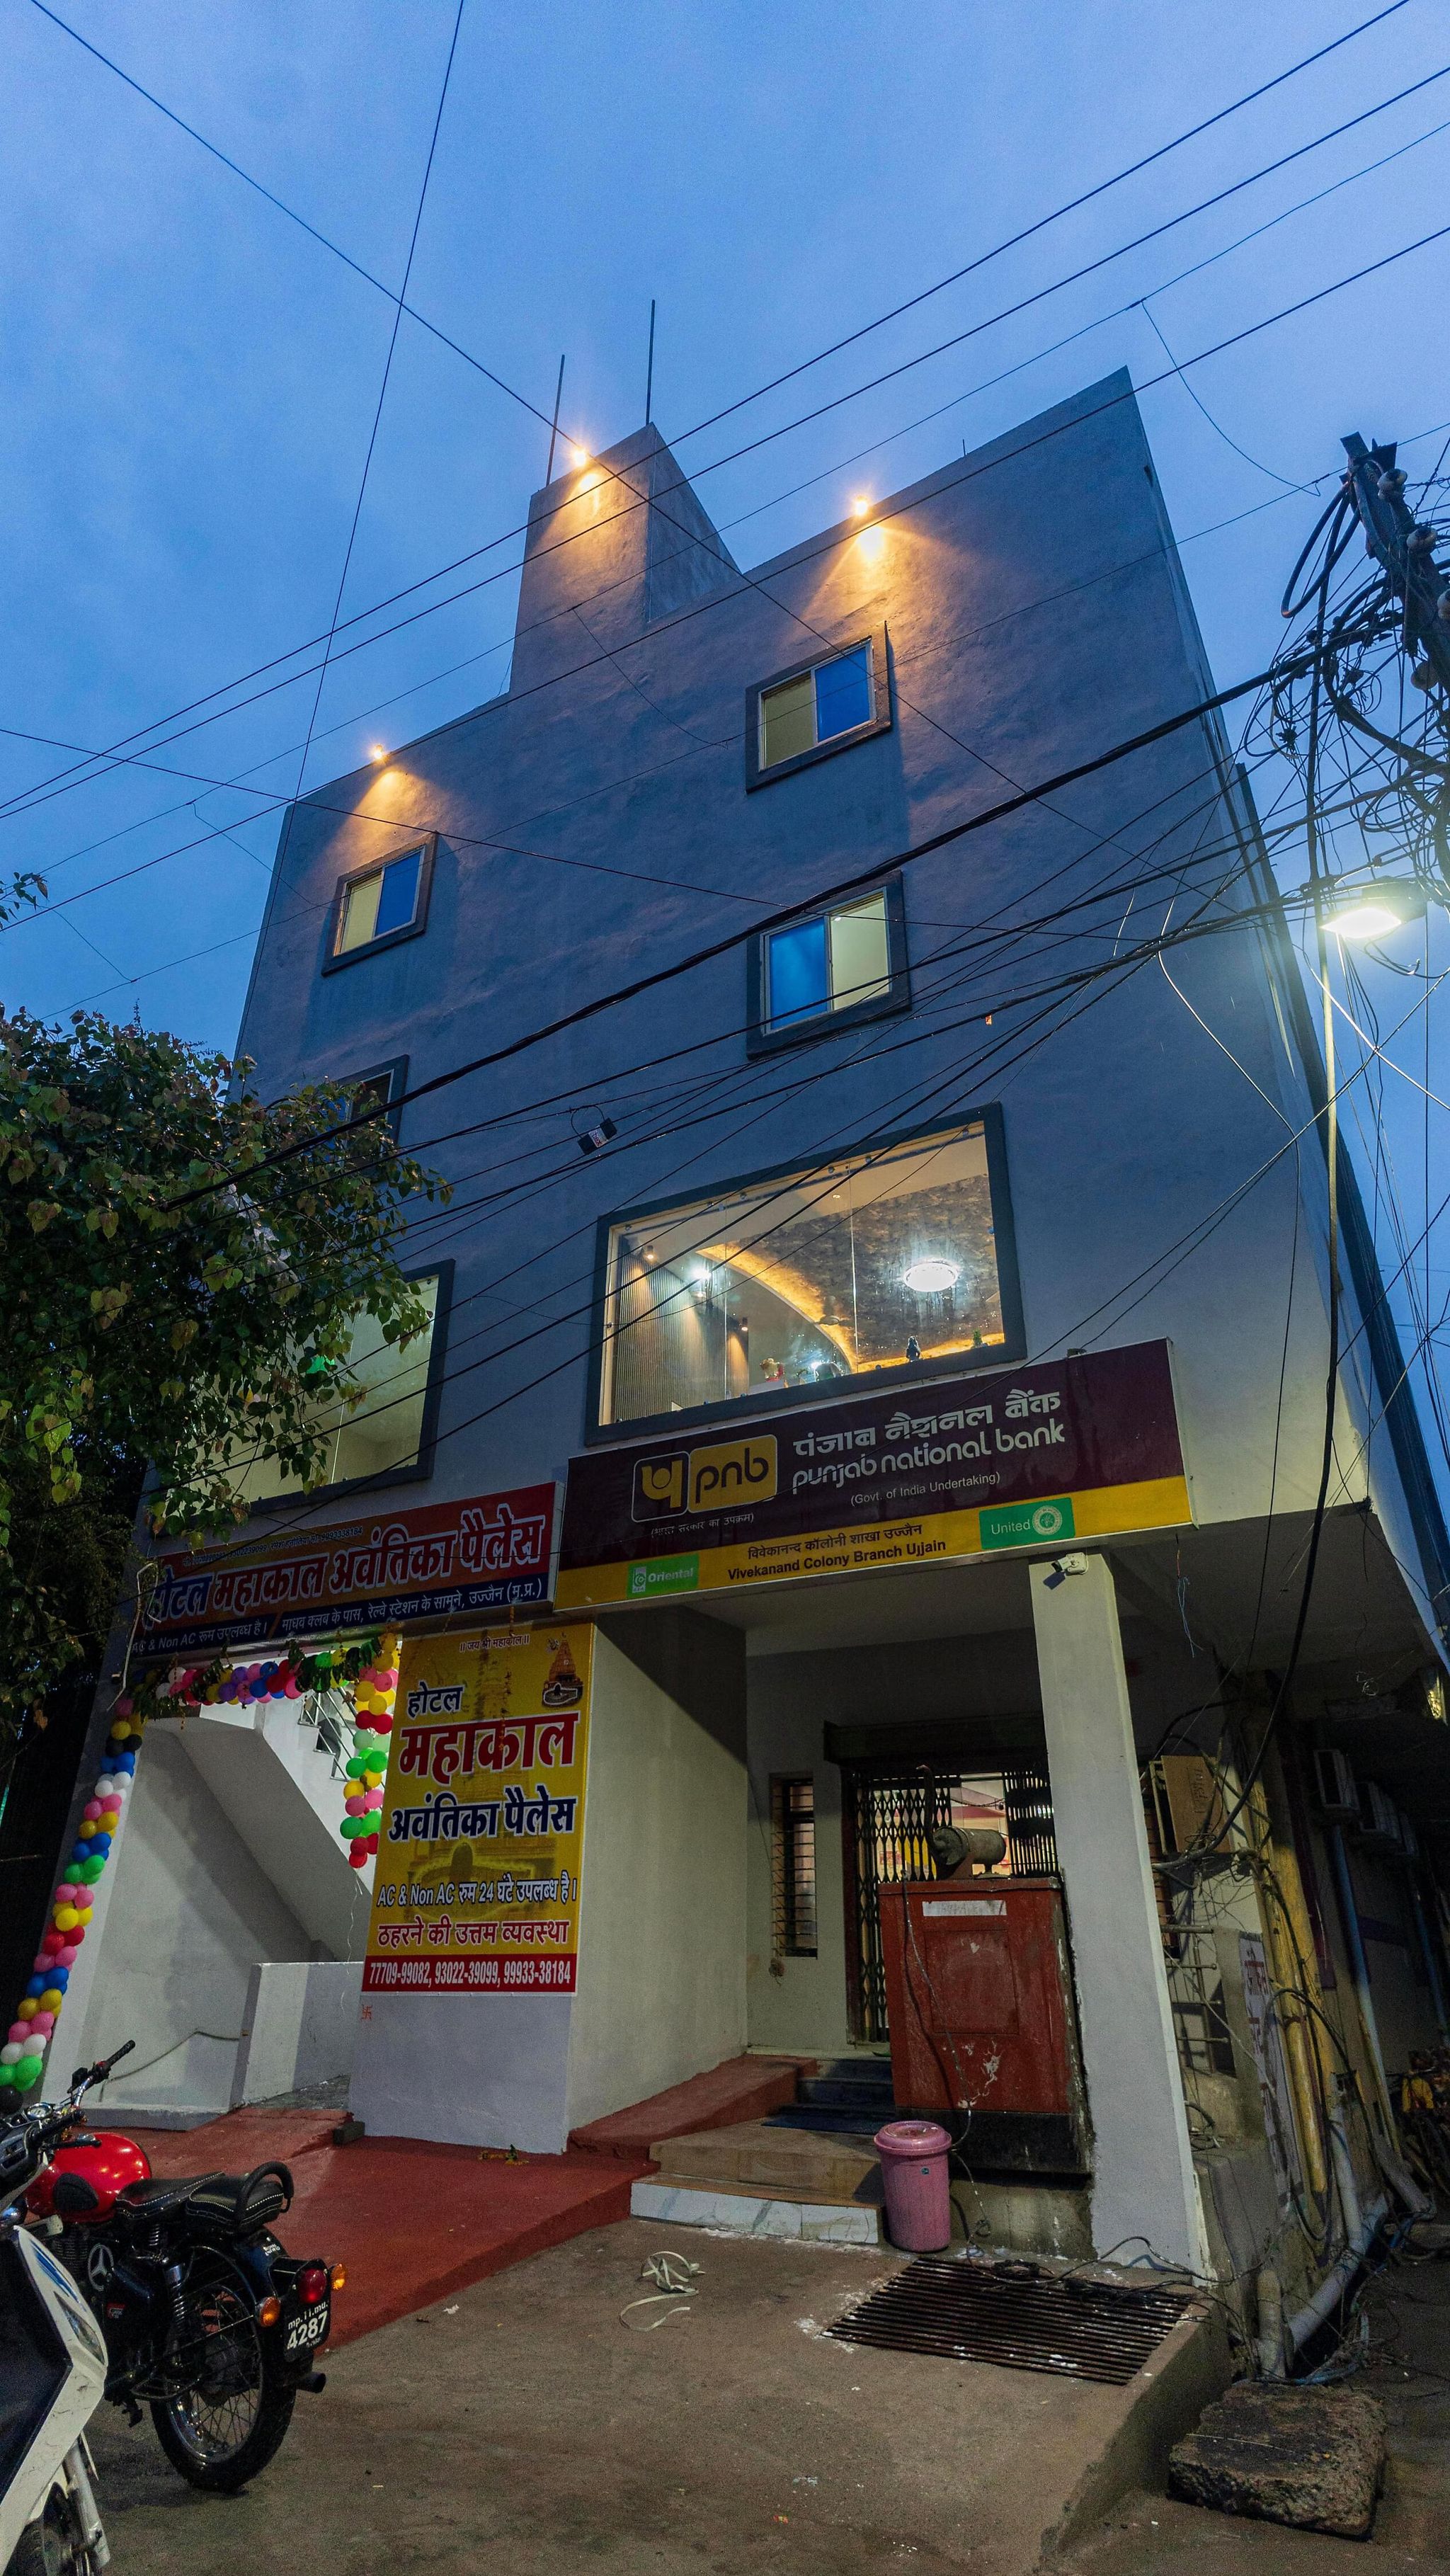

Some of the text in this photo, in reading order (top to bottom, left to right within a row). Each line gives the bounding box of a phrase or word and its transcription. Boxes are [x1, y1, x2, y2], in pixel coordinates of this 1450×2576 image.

[792, 1389, 1061, 1457] पंजाब नैशनल बैंक
[695, 1447, 769, 1504] pnb
[792, 1418, 1066, 1495] punjab national bank
[850, 1471, 1000, 1507] (Govt. of India Undertaking)
[708, 1517, 721, 1529] का
[748, 1522, 923, 1559] विवेकानन्द कॉलोनी शाखा उज्जैन
[991, 1519, 1030, 1535] United
[213, 1552, 330, 1617] महाकाल
[329, 1524, 459, 1593] अवंतिका
[459, 1503, 545, 1572] पैलेस
[648, 1567, 694, 1584] Oriental
[728, 1539, 946, 1580] Vivekanand Colony Branch Ujjain
[282, 1617, 304, 1631] माधव
[308, 1612, 329, 1628] क्लब
[331, 1608, 341, 1624] के
[389, 1599, 419, 1615] स्टेशन
[421, 1594, 432, 1611] के
[469, 1585, 504, 1605] उज्जैन
[148, 1639, 155, 1651] &
[159, 1636, 178, 1650] Non
[181, 1632, 197, 1646] AC
[408, 1680, 464, 1719] होटल
[399, 1710, 581, 1786] महाकाल
[389, 1783, 578, 1841] अवंतिका पैलेस
[377, 1884, 396, 1907] AC
[398, 1883, 407, 1905] &
[409, 1883, 434, 1906] Non
[435, 1881, 455, 1905] AC
[479, 1879, 493, 1903] 24
[516, 1877, 559, 1903] उपलब्ध
[377, 1914, 571, 1949] ठहरने की उत्तम व्यवस्था
[370, 1960, 571, 1988] 77709-99082, 93022-39099, 99933-38184
[287, 2310, 328, 2350] 4287
